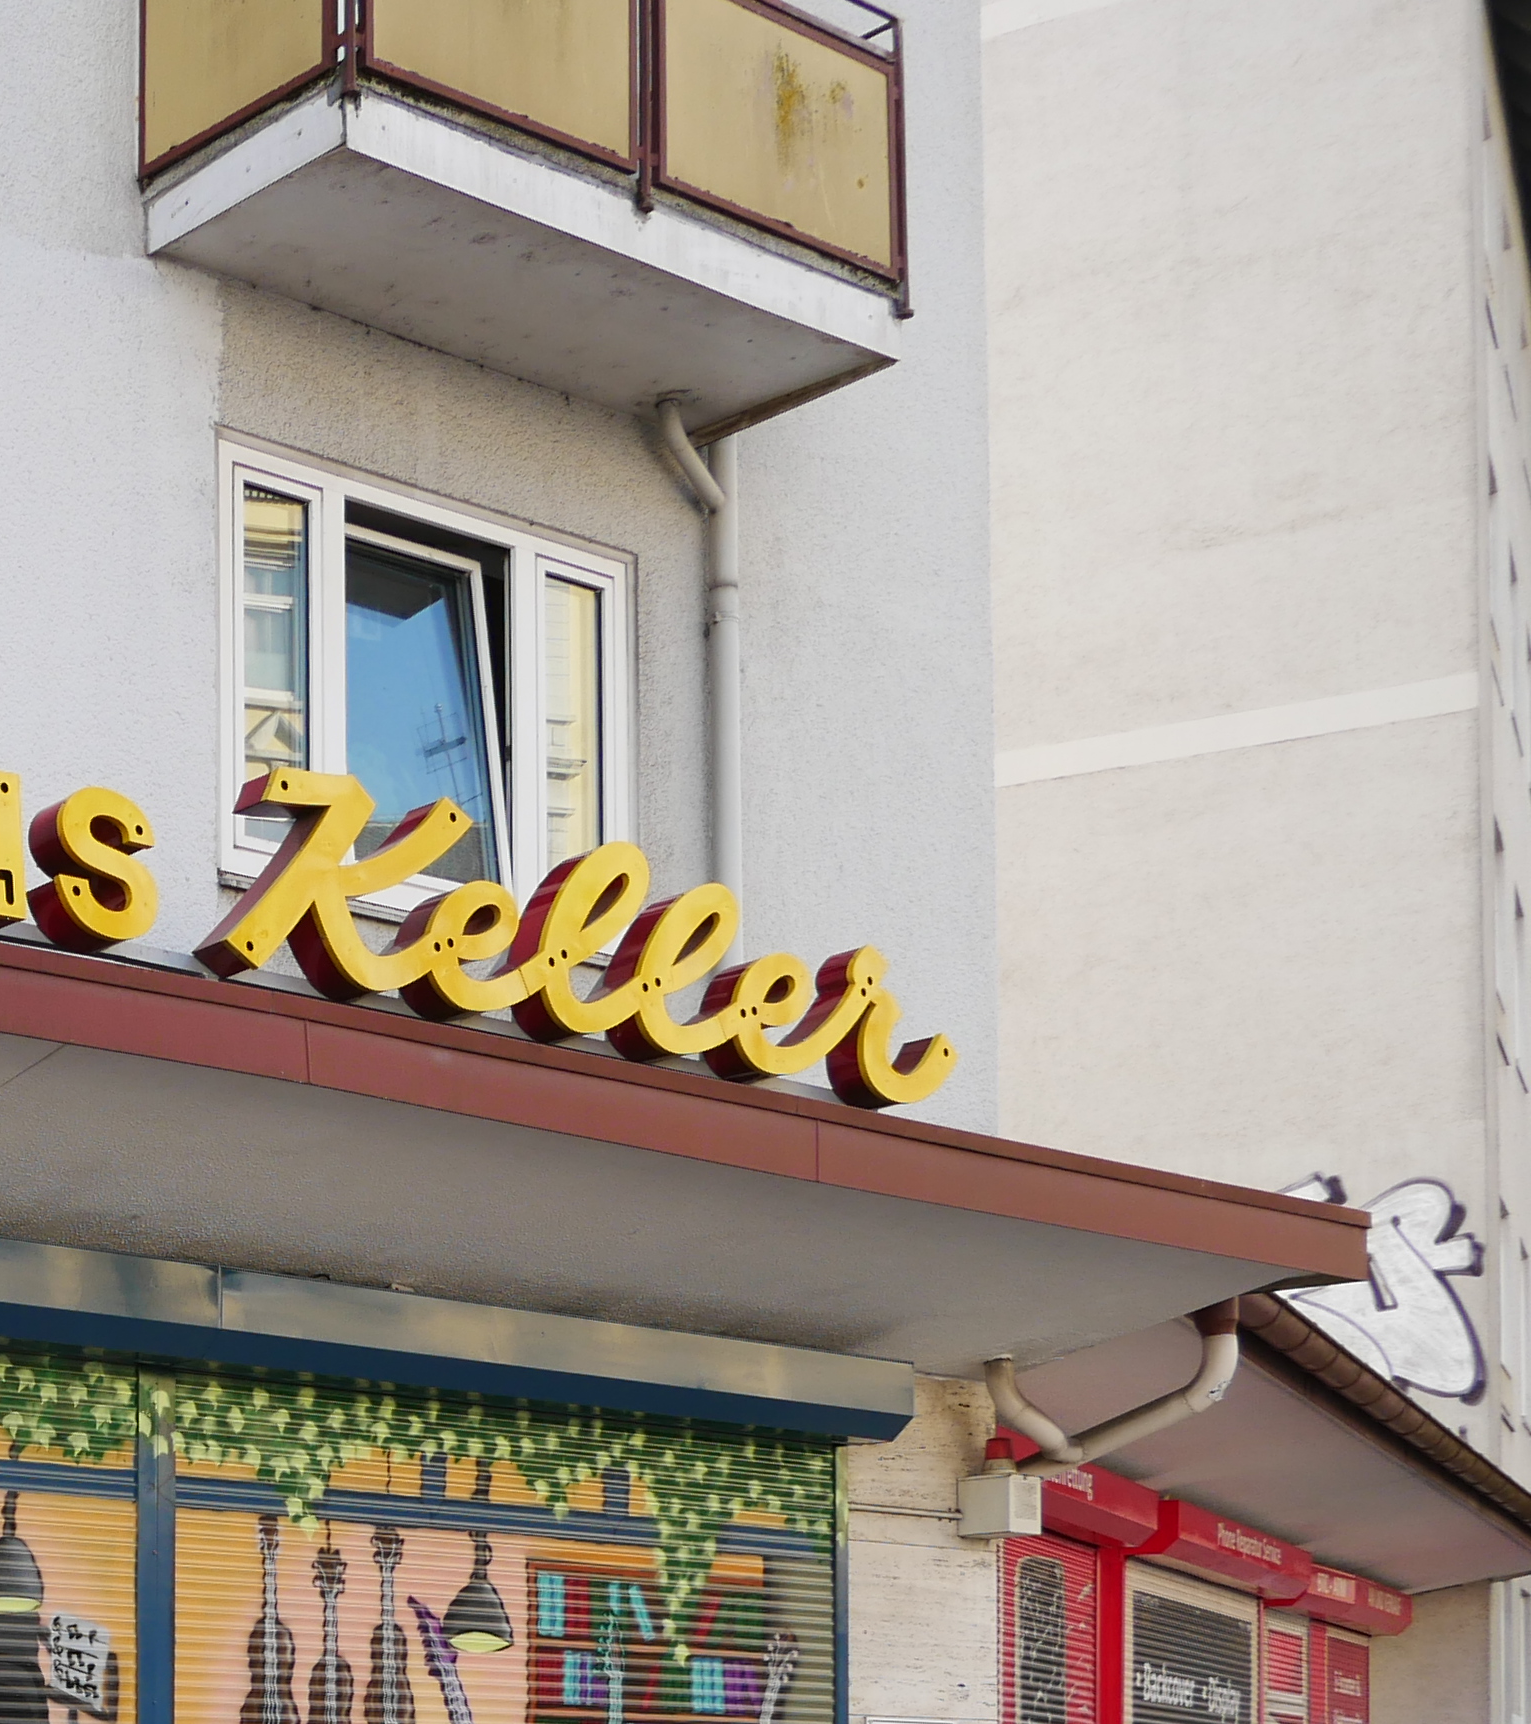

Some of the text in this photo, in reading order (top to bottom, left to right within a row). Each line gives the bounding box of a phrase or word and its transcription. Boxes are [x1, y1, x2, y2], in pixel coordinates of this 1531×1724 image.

[195, 766, 959, 1106] Keller
[1217, 1522, 1236, 1550] Phone
[1263, 1537, 1282, 1565] Service
[1143, 1662, 1240, 1724] Backcover Display
